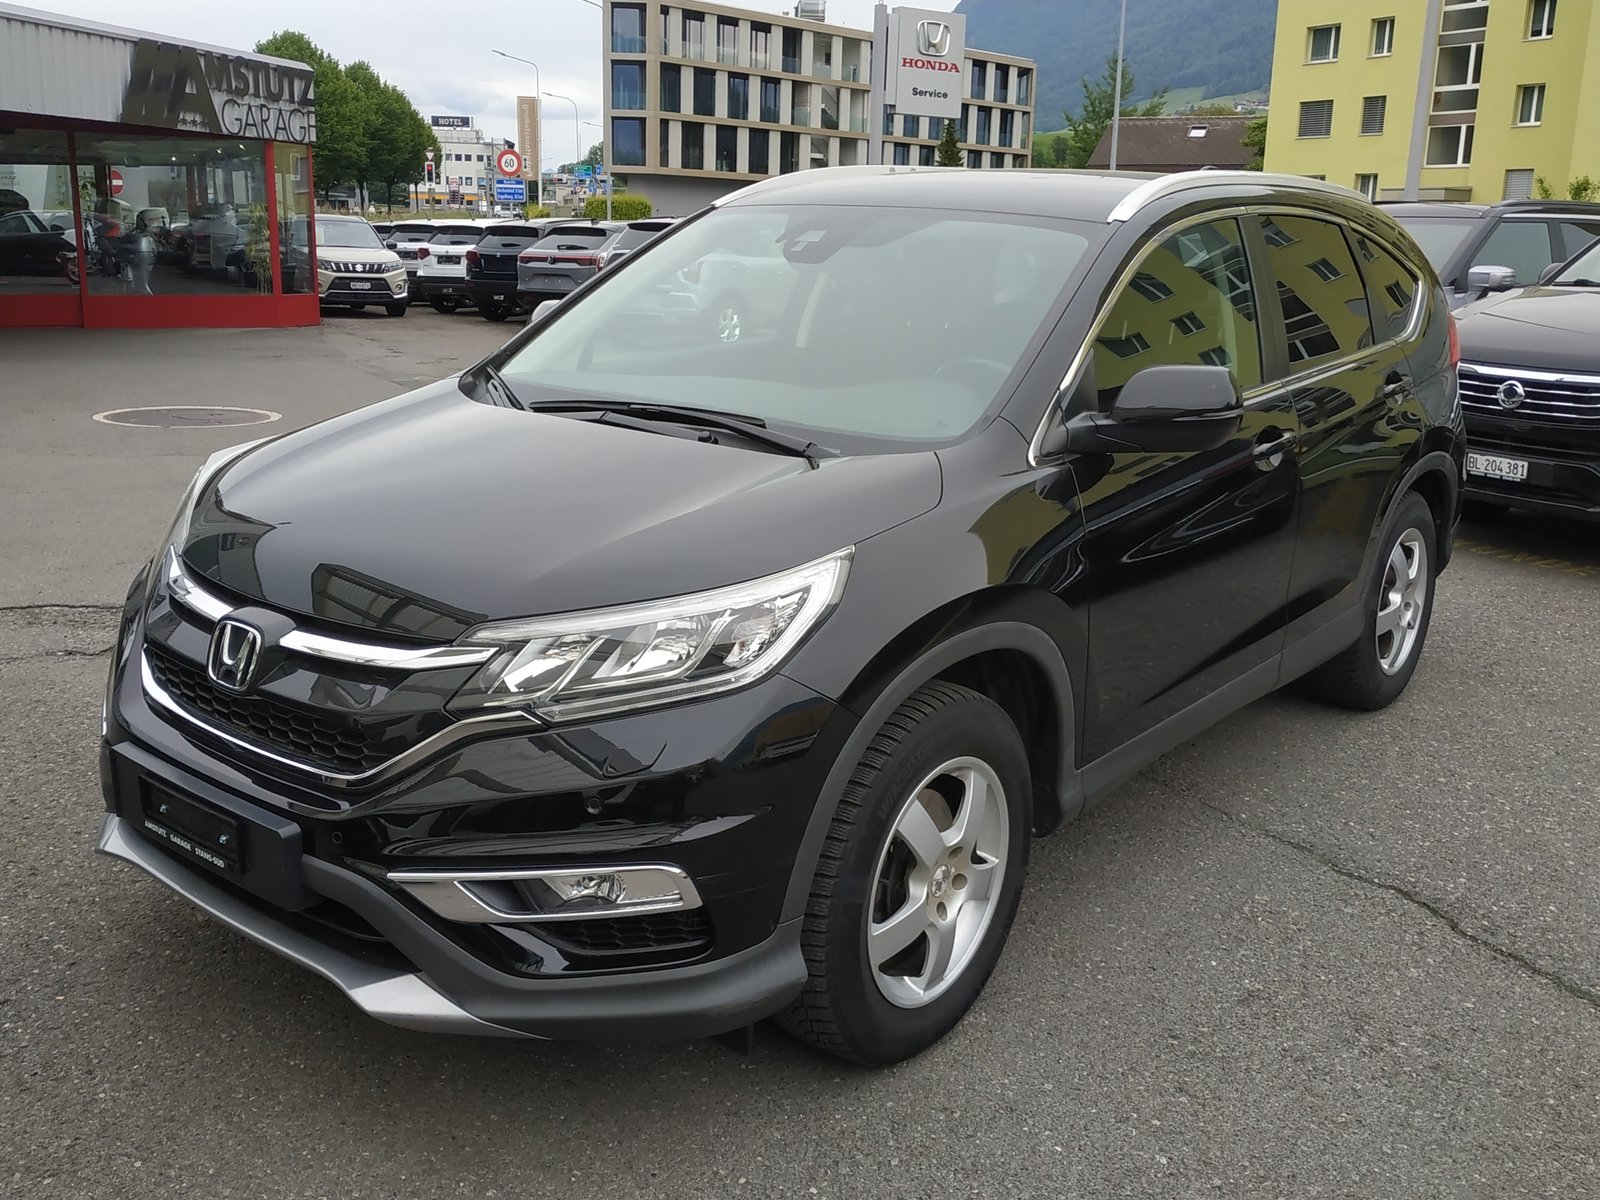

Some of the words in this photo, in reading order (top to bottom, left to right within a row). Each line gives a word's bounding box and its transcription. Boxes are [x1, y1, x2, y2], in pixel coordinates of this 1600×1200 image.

[901, 57, 961, 73] HONDA
[912, 87, 948, 99] Service
[438, 117, 463, 126] HOTEL
[504, 158, 515, 168] 60
